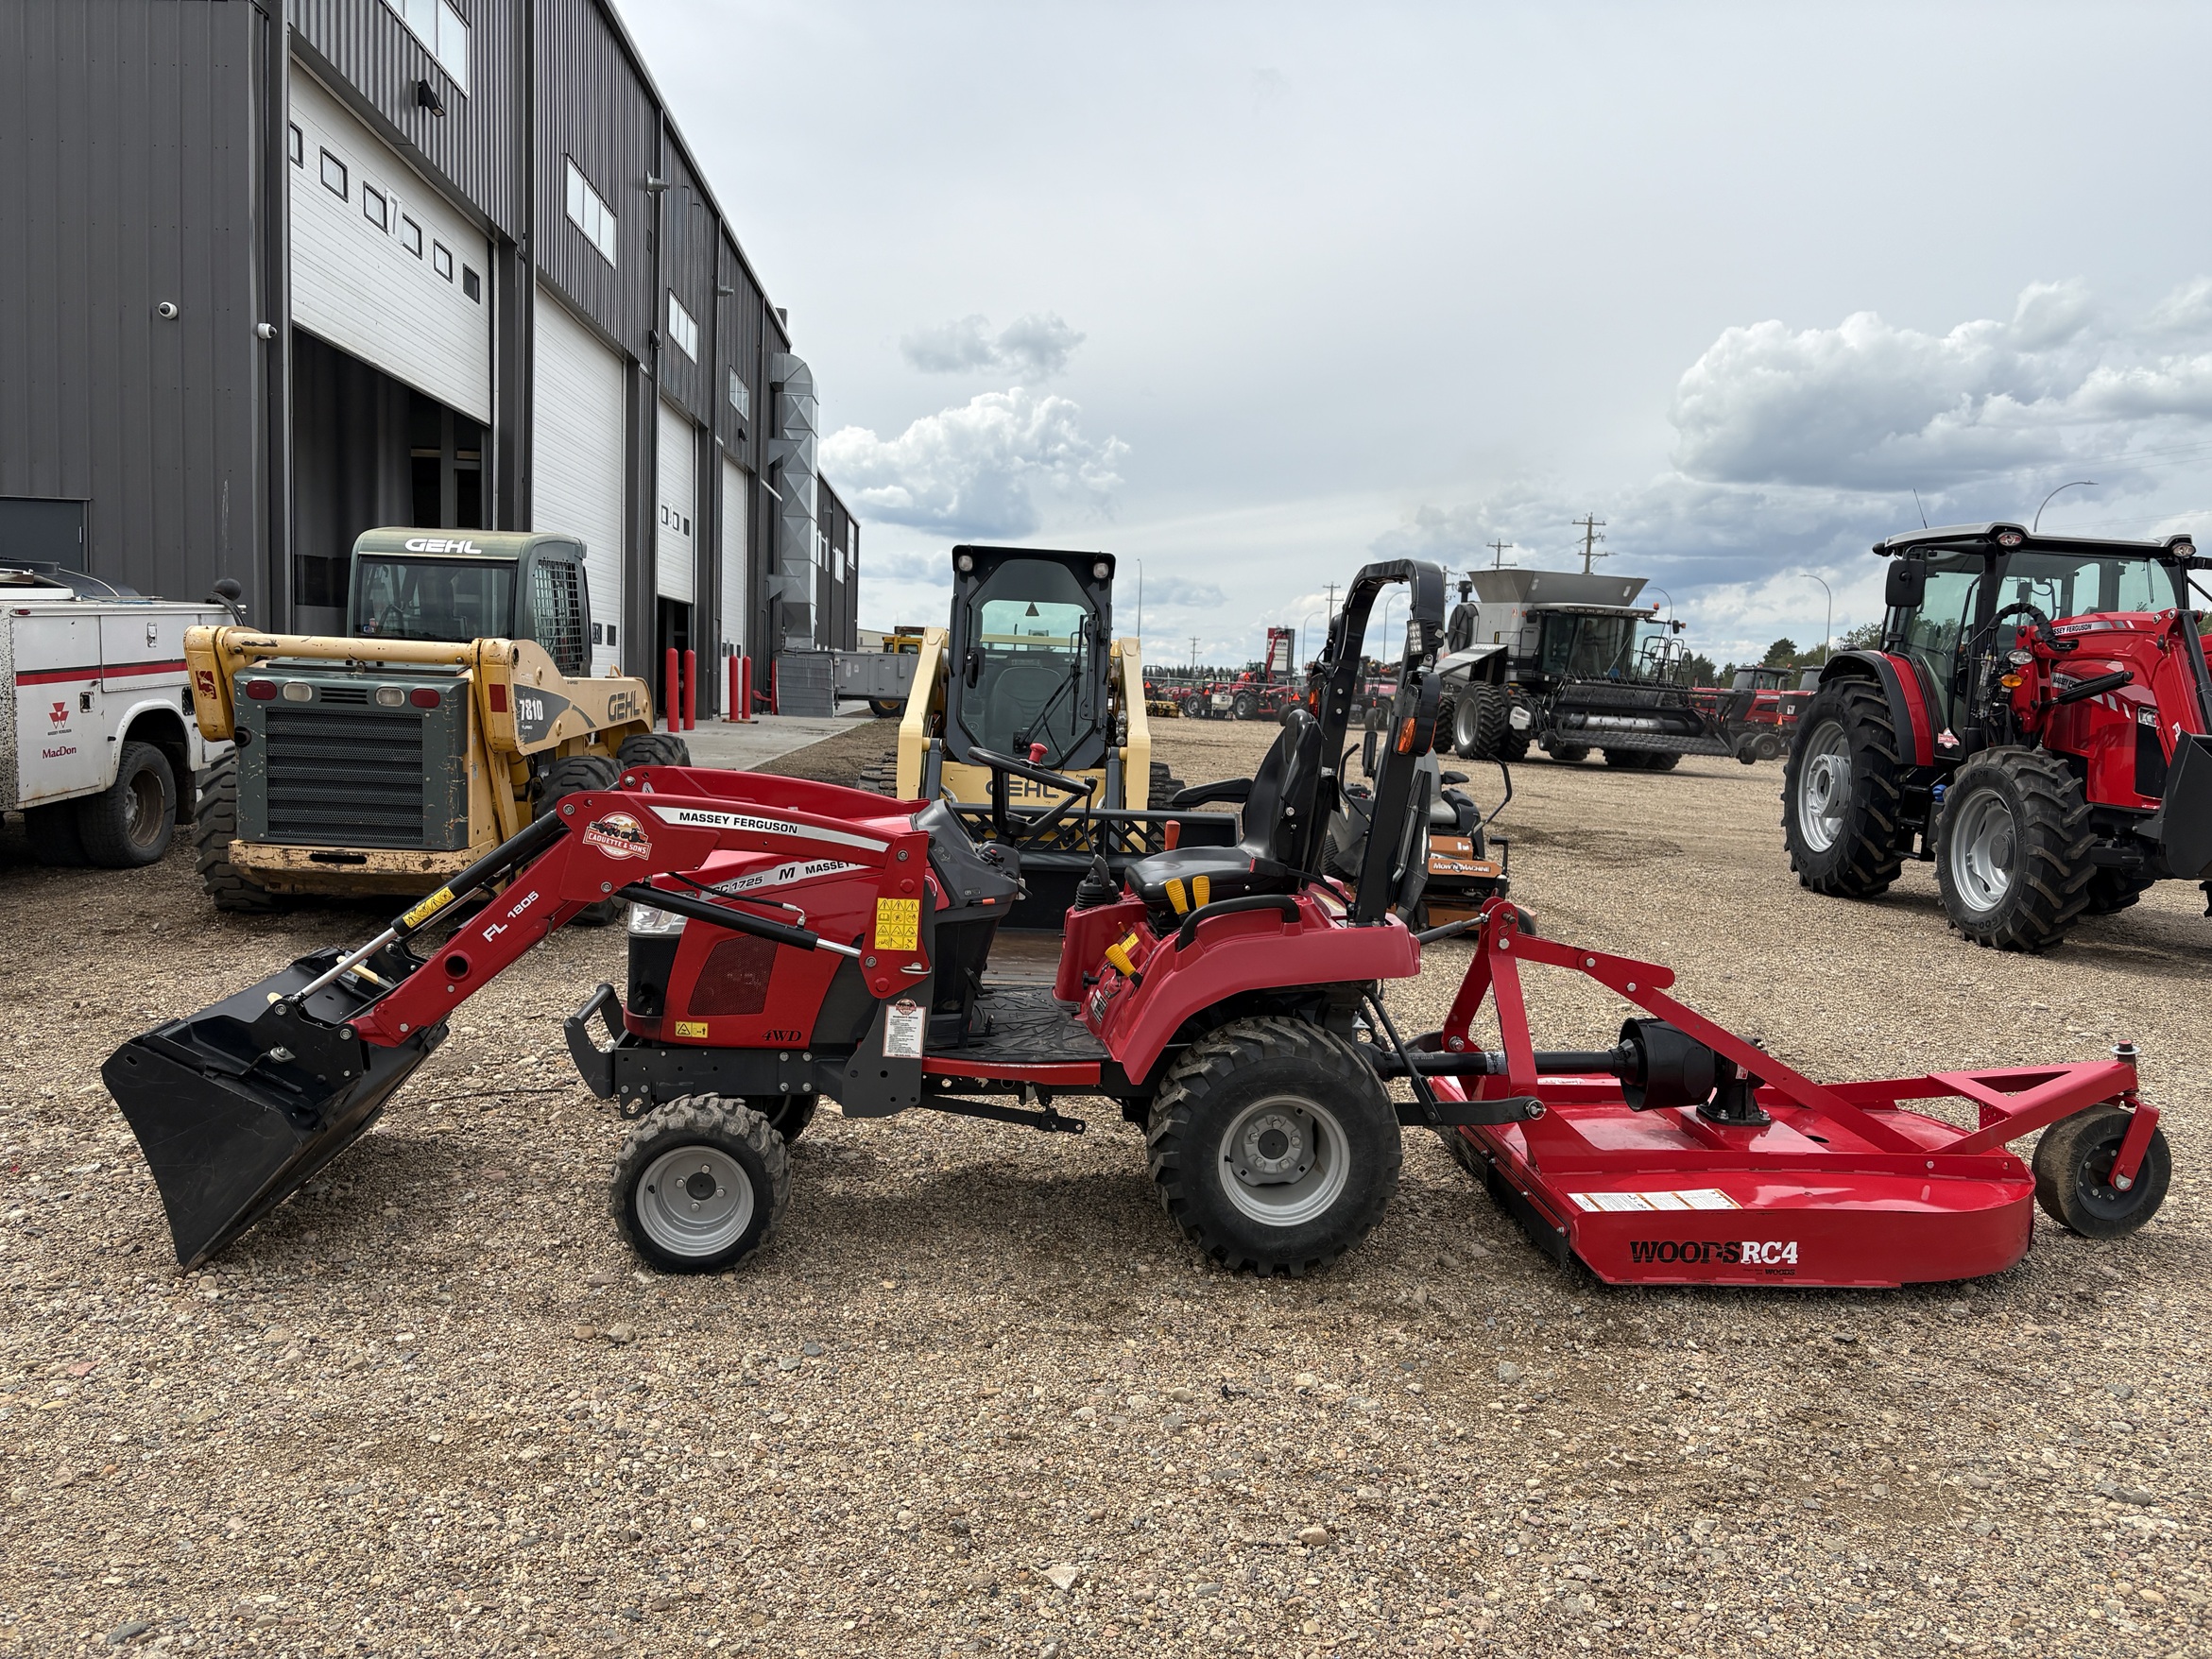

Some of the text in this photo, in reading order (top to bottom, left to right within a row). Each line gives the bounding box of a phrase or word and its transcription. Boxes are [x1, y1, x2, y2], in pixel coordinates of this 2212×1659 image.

[404, 539, 482, 555] GEHL
[520, 698, 544, 721] 7810
[608, 690, 642, 723] GEHL
[43, 745, 77, 760] MacDon
[679, 812, 797, 834] MASSEY FERGUSON
[628, 843, 647, 854] SONS
[731, 876, 763, 892] 1725
[482, 890, 540, 943] FL 1805
[762, 1030, 802, 1042] 4WD
[1764, 1268, 1795, 1276] WOODS
